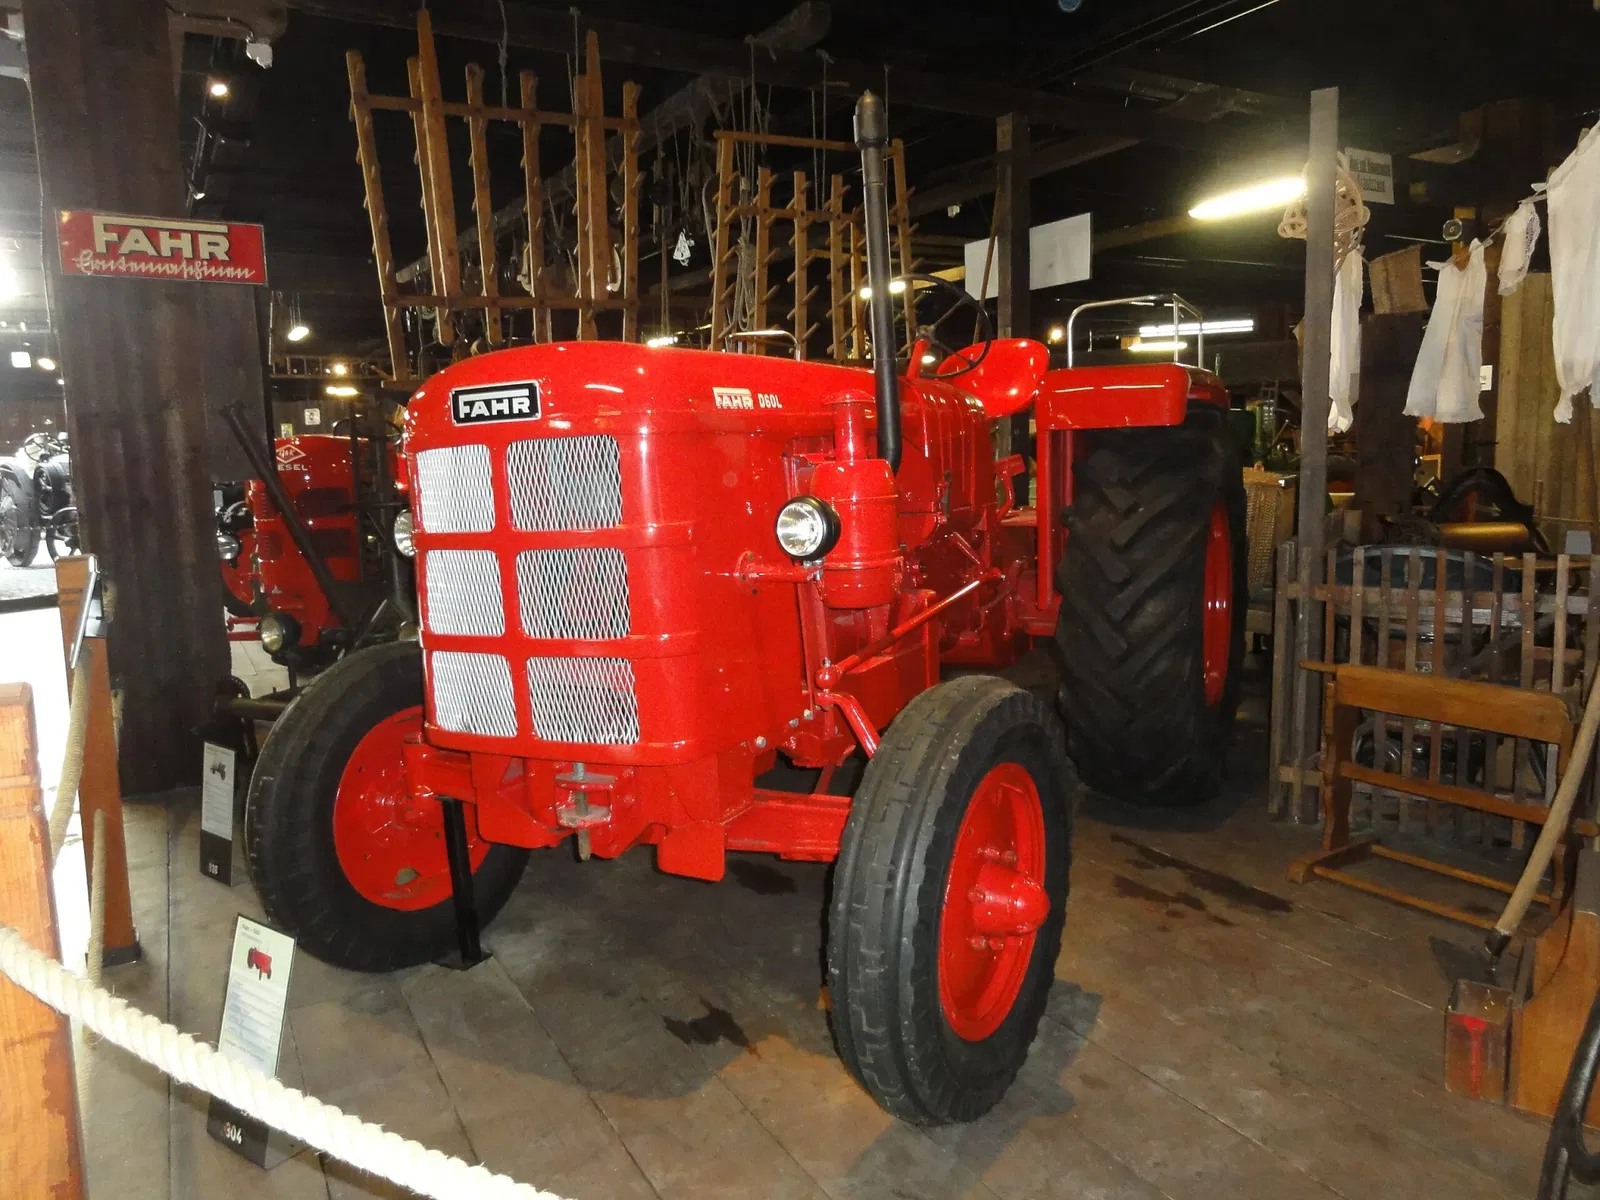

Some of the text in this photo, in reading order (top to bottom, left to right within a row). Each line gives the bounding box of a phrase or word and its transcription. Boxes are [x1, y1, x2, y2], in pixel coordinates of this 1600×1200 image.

[93, 215, 230, 261] FAHR
[458, 388, 530, 418] FAHR
[712, 387, 754, 409] FAHR
